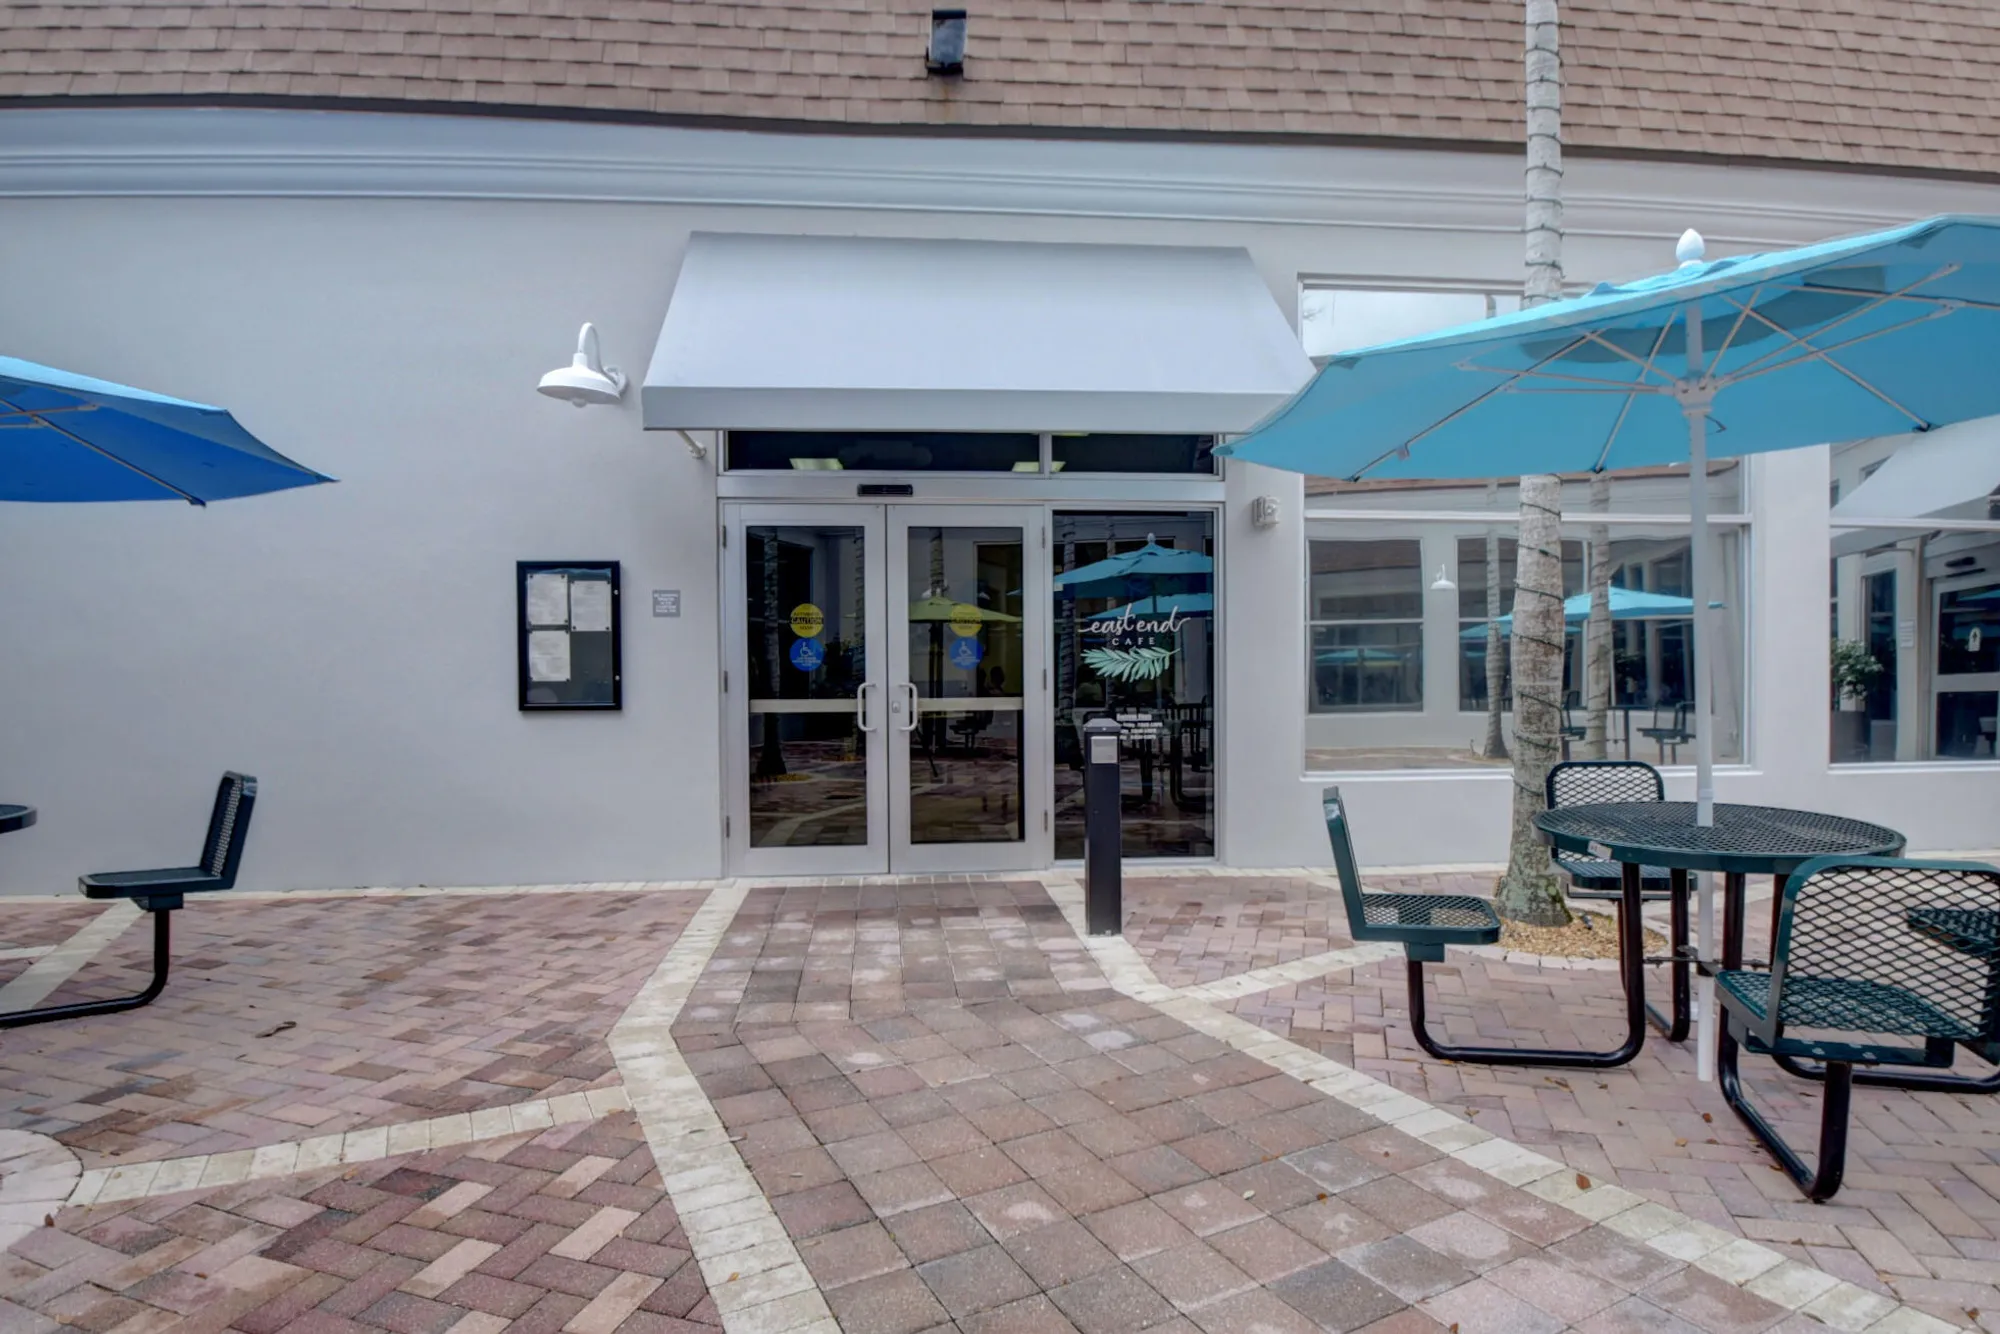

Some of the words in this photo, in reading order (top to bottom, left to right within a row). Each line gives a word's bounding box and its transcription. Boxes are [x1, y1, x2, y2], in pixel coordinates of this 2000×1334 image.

[792, 616, 823, 625] CAUTION
[1078, 603, 1136, 635] east
[1136, 605, 1191, 633] end
[1111, 637, 1155, 645] CAFE
